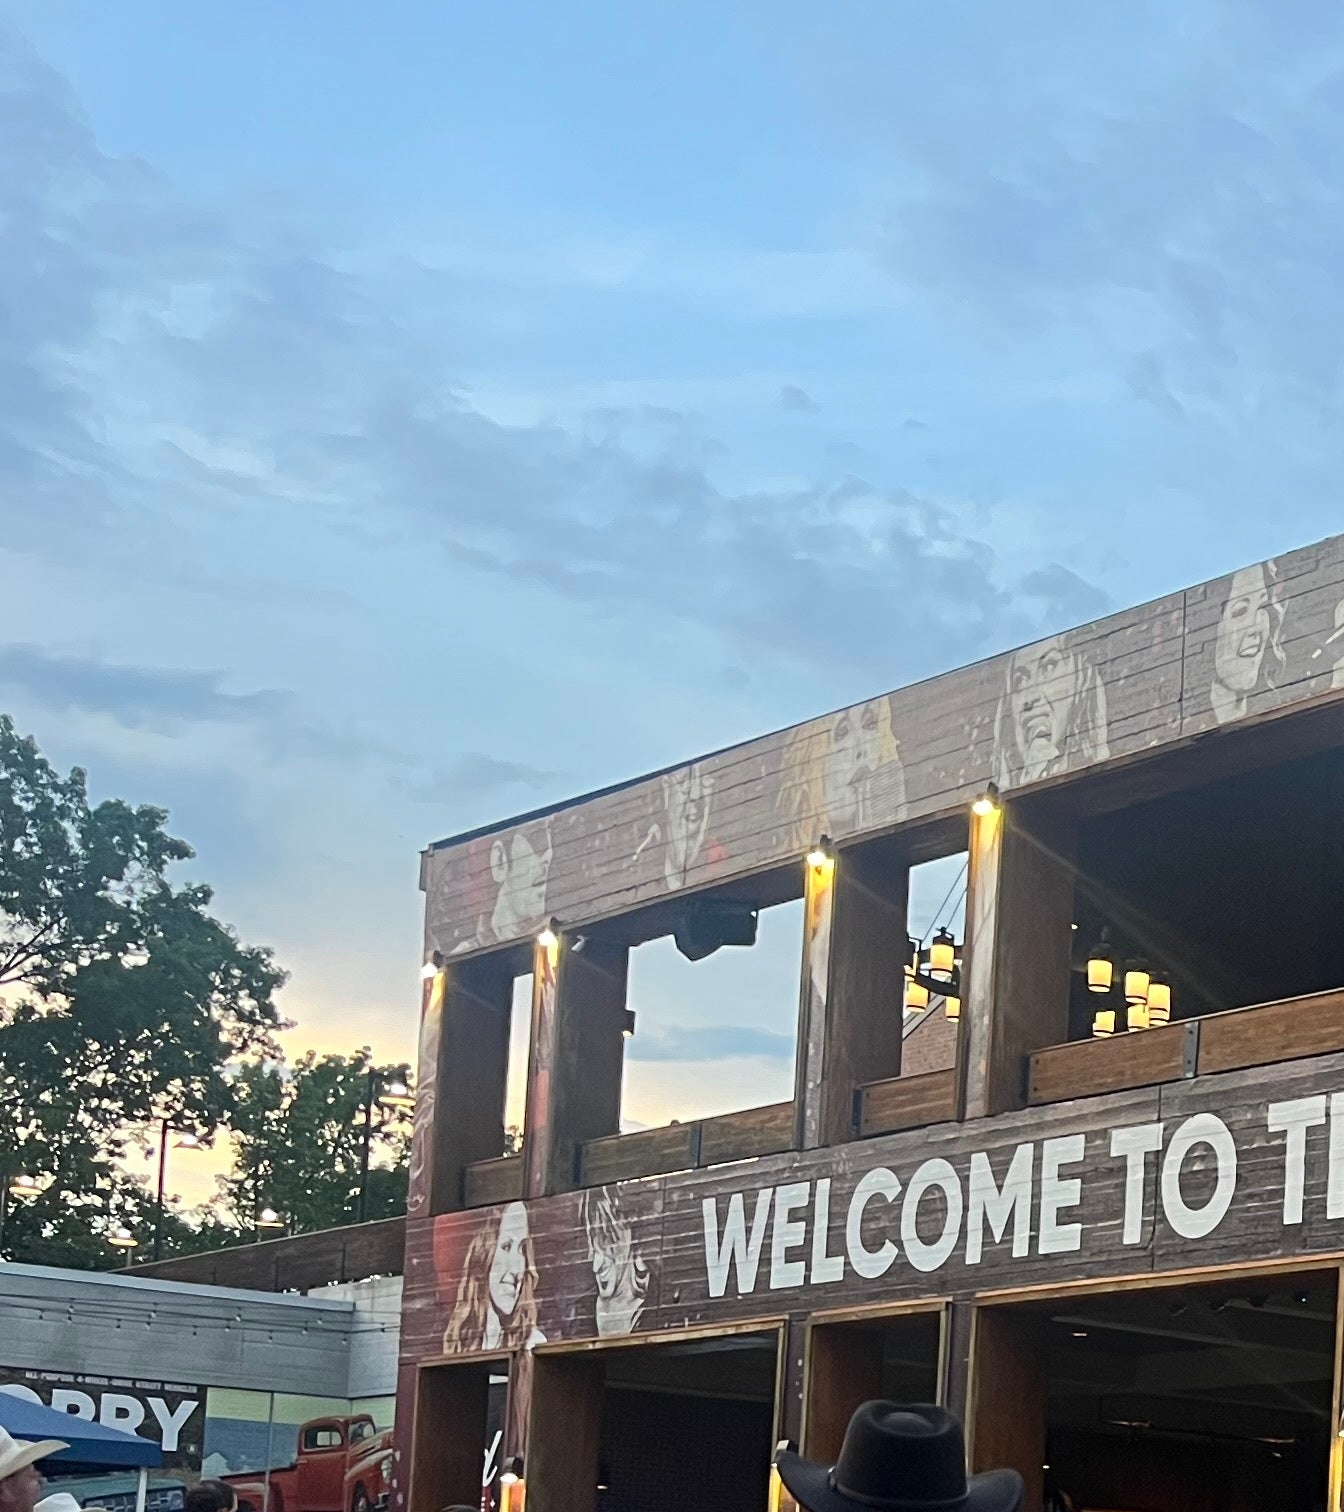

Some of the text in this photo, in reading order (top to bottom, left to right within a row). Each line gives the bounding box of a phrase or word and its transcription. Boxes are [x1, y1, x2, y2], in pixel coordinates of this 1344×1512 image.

[702, 1133, 1086, 1298] WELCOME
[1111, 1112, 1237, 1246] TO
[0, 1384, 199, 1451] PRY
